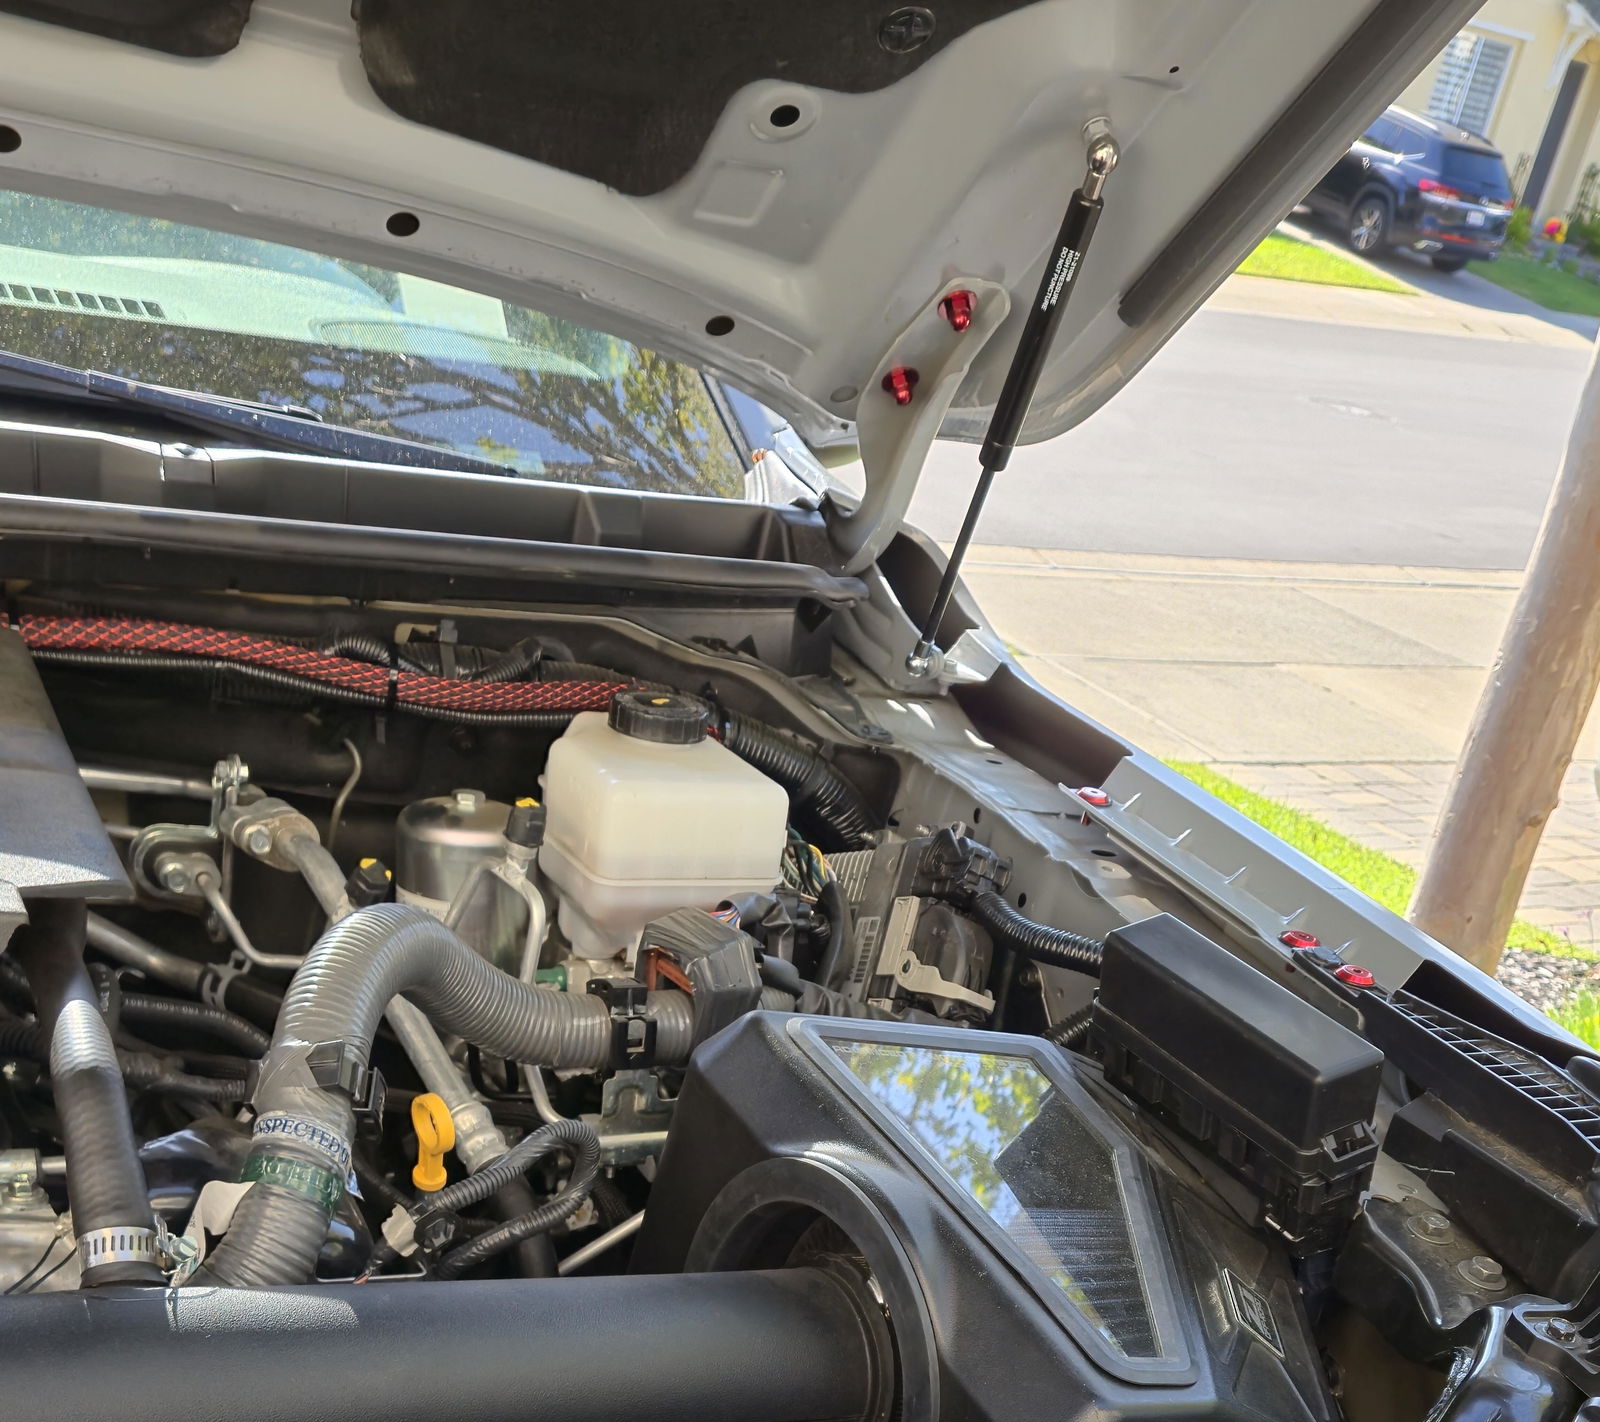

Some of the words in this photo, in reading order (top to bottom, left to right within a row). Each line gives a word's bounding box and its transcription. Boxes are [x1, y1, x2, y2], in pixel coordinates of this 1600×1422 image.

[1060, 246, 1069, 258] DO
[1064, 250, 1075, 268] HIGH
[1055, 257, 1065, 274] NOT
[1041, 273, 1059, 311] PUNCTURE
[1050, 267, 1069, 306] PRESSURE
[255, 1117, 340, 1152] INSPECTED
